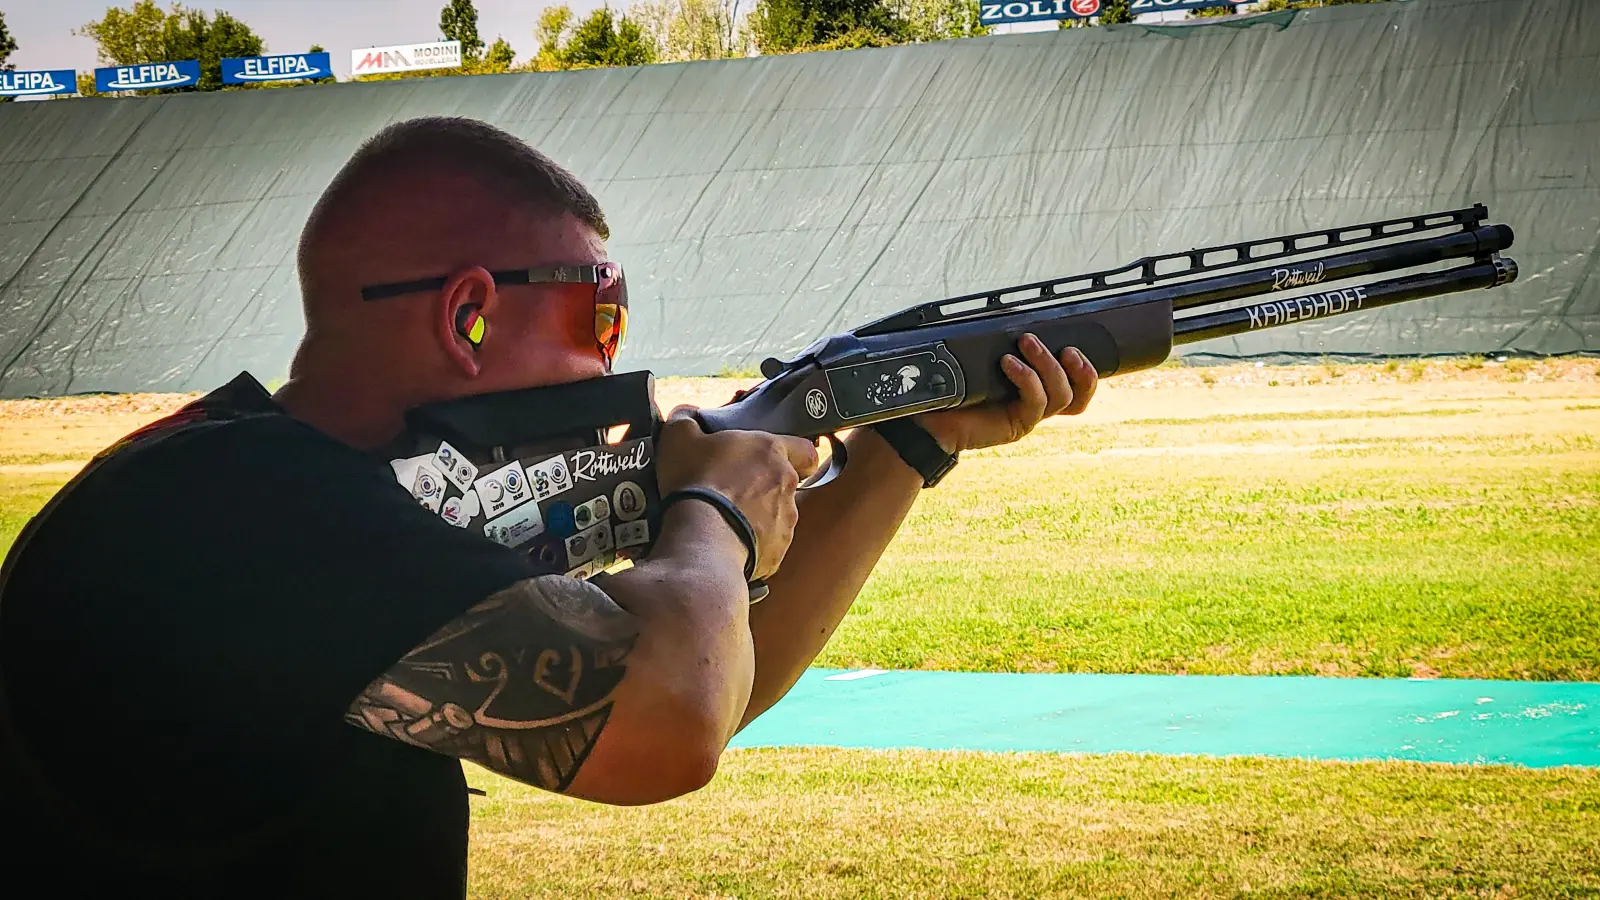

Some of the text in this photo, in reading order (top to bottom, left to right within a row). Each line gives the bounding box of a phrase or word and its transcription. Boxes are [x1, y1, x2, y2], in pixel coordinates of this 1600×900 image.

[981, 0, 1067, 20] ZOLI
[414, 45, 458, 58] MODINI
[117, 64, 181, 85] ELFIPA
[244, 56, 310, 76] ELFIPA
[1271, 261, 1327, 291] Rottweil
[1246, 287, 1368, 329] KRIEGHOFF
[570, 441, 651, 483] Rottweil
